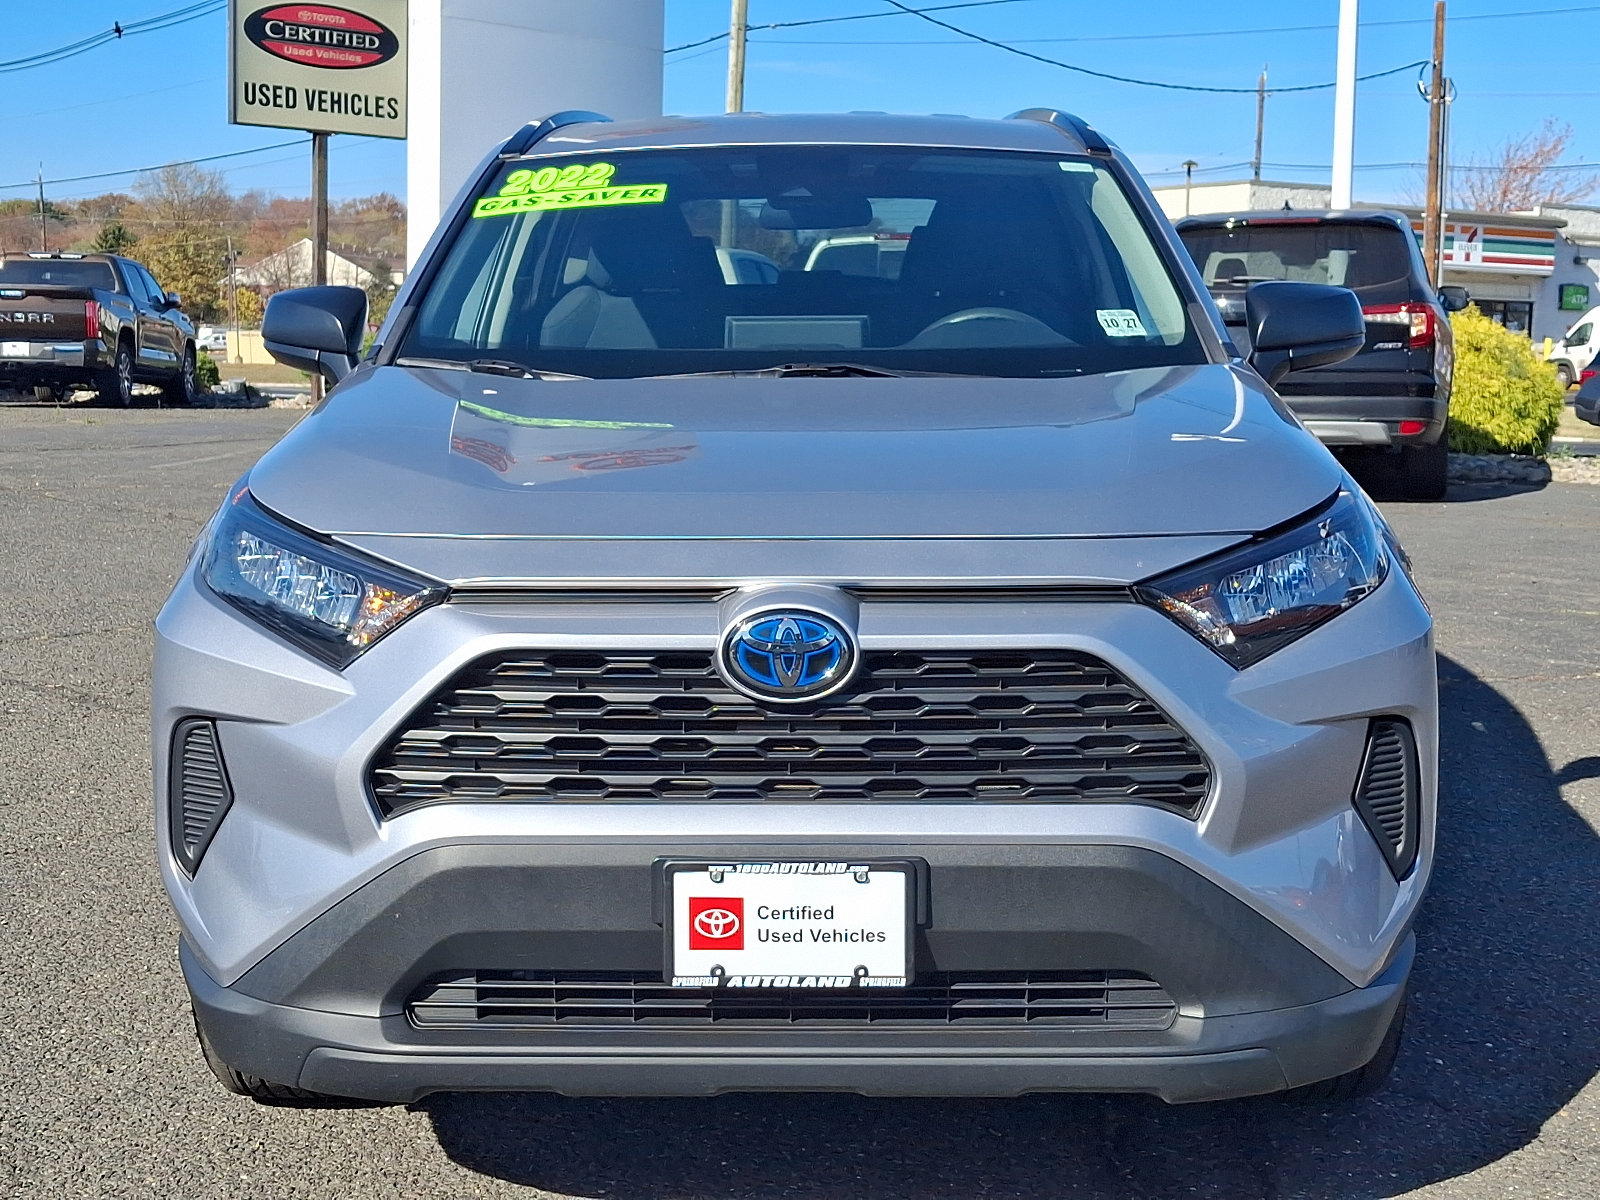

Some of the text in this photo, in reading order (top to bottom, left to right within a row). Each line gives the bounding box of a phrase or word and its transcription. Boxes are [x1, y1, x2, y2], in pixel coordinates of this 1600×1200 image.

[312, 12, 346, 24] TOYOTA
[264, 21, 380, 49] CERTIFIED
[284, 46, 362, 63] Used Vehicles
[244, 82, 399, 119] USED VEHICLES
[500, 162, 616, 196] 2022
[479, 188, 660, 211] GAS-SAVER
[1103, 318, 1137, 329] 10 27
[757, 905, 834, 920] Certified
[757, 928, 886, 943] Used Vehicles
[726, 976, 851, 988] AUTOLAND
